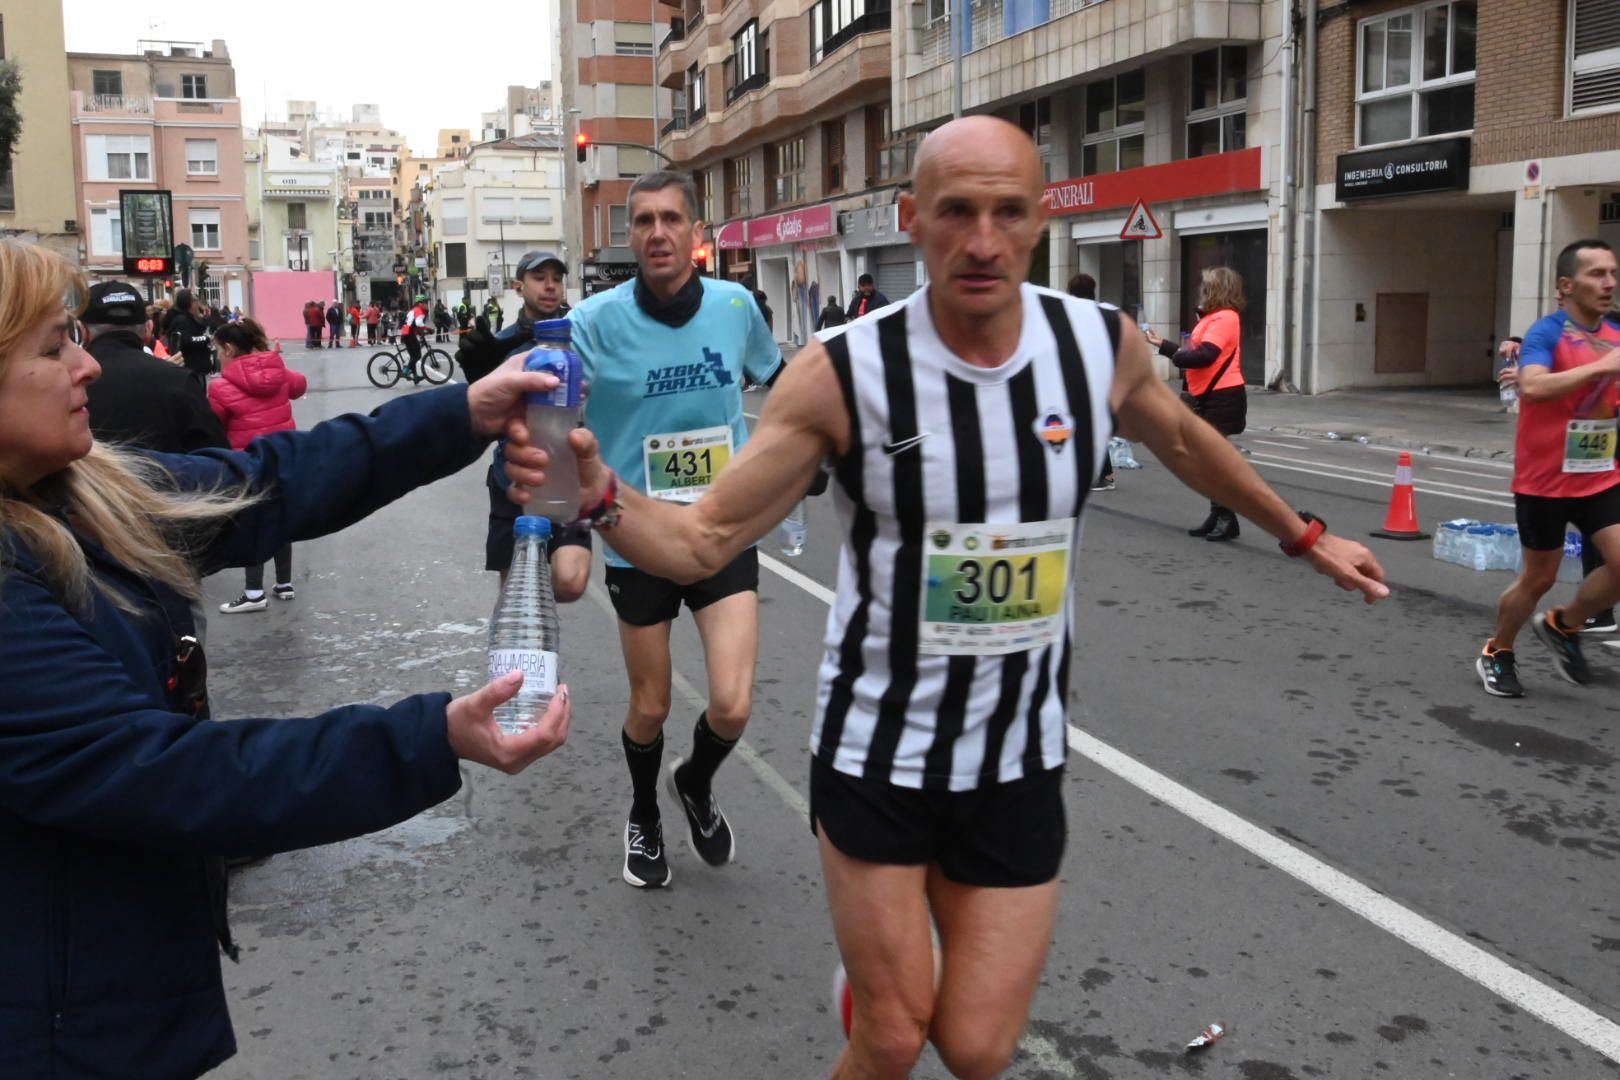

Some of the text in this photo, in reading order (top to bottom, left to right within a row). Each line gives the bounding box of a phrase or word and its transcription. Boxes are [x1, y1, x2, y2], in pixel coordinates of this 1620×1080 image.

[1344, 168, 1383, 181] INGENIERIA
[1395, 160, 1448, 175] CONSULTORIA
[138, 259, 164, 270] 10:03
[646, 375, 711, 393] TRAIL
[664, 448, 712, 477] 431
[670, 475, 712, 488] ALBERT
[956, 556, 1038, 604] 301
